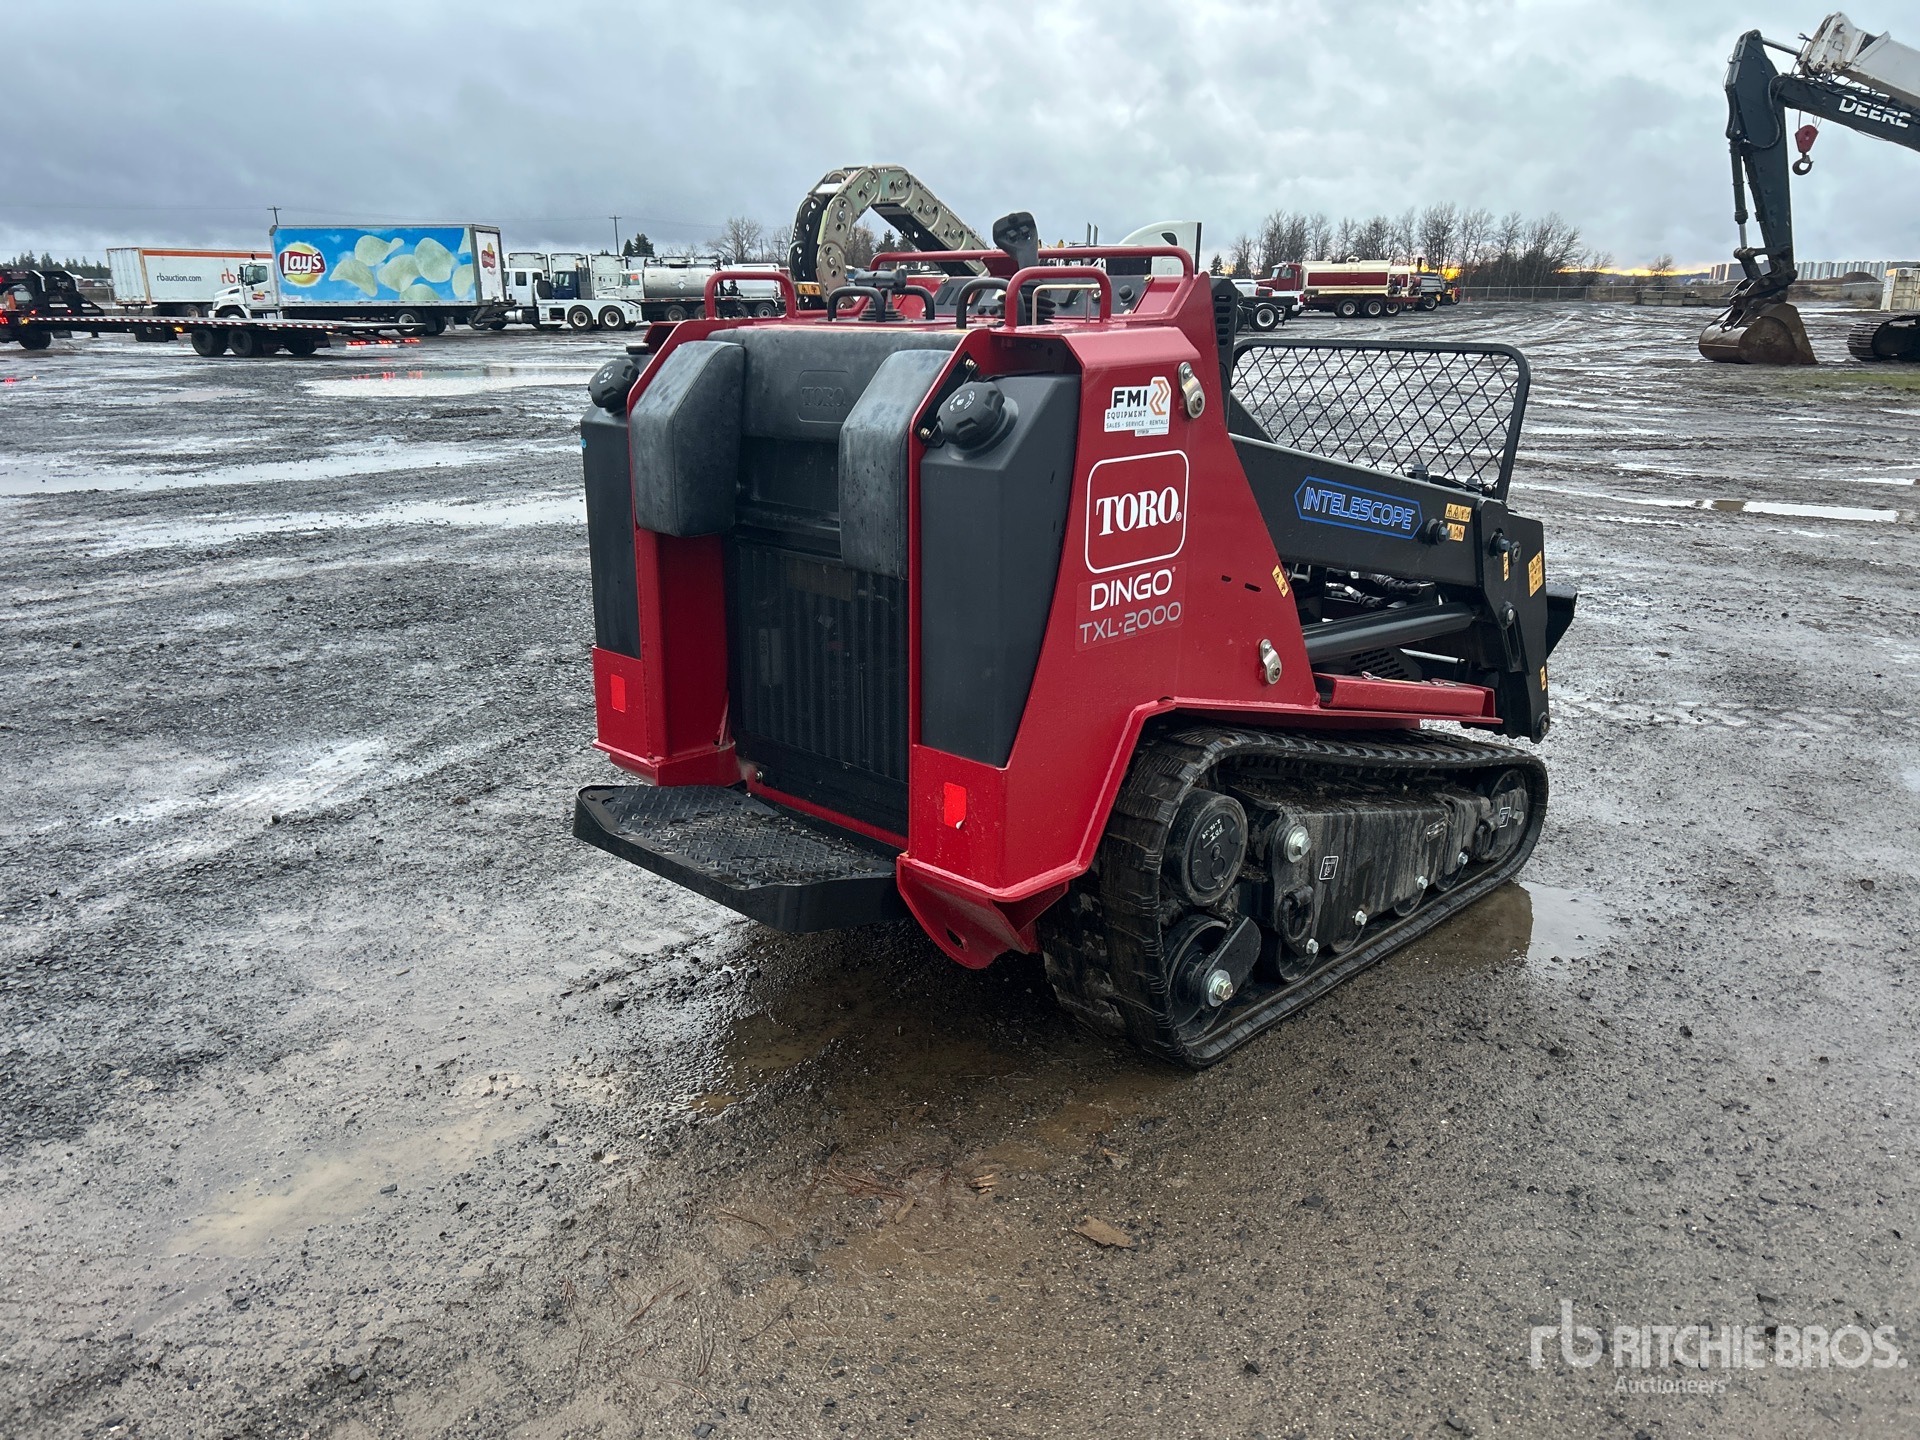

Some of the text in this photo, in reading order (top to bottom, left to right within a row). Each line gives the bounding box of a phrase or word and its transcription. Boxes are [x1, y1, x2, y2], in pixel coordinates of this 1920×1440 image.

[1838, 94, 1912, 129] DEERE
[283, 251, 322, 274] Lay's
[156, 272, 202, 282] rbauction.com
[1113, 389, 1148, 409] FMI
[1106, 410, 1147, 420] EQUIPMENT
[1149, 418, 1168, 426] RENTALS
[1095, 486, 1179, 536] TORO
[1303, 486, 1414, 530] INTELESCOPE
[1090, 568, 1173, 612] DINGO
